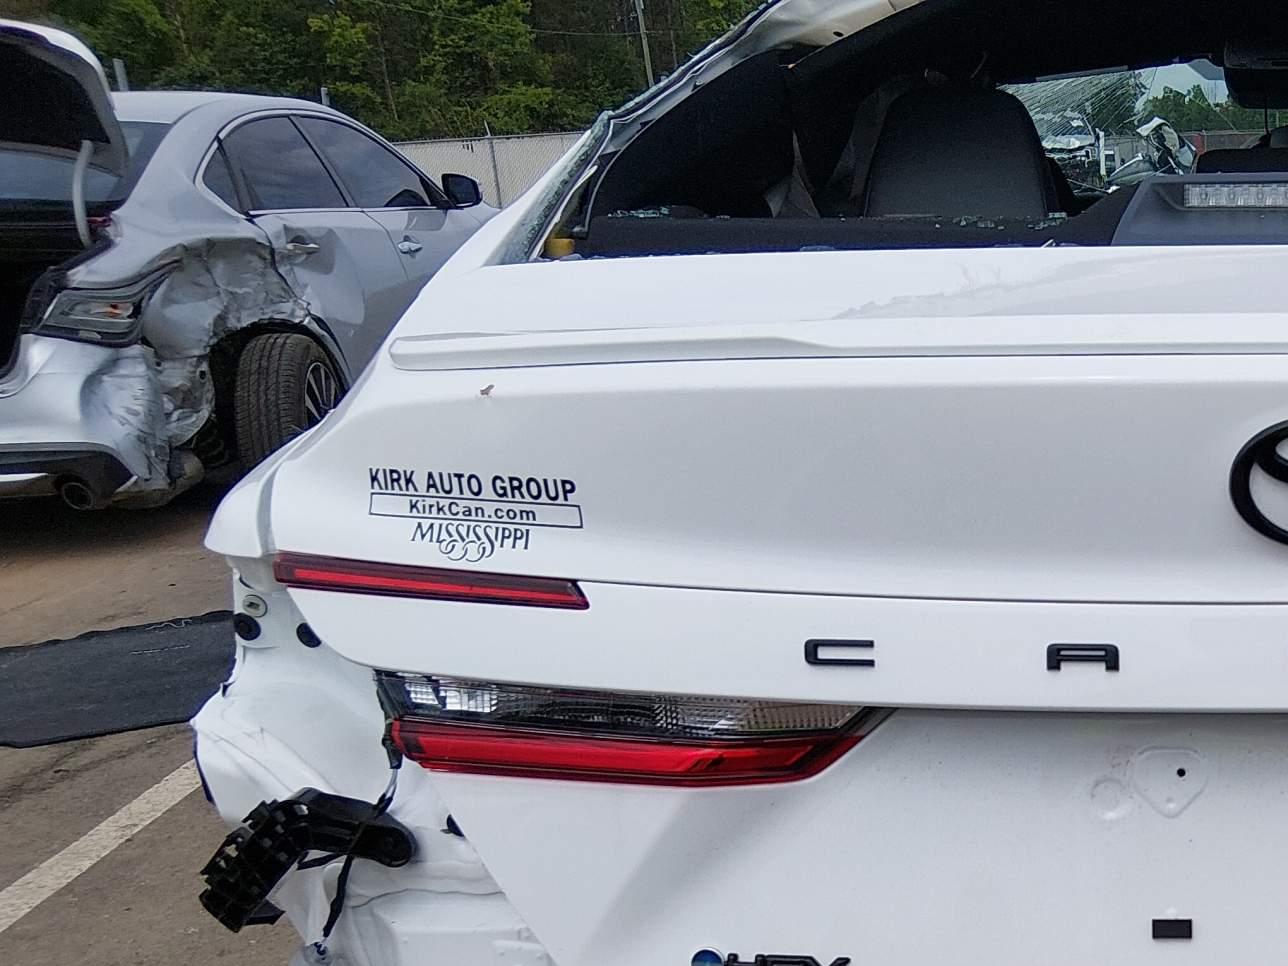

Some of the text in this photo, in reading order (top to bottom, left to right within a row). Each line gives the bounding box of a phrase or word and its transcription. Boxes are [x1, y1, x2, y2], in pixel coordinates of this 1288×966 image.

[369, 467, 577, 501] KIRK AUTO GROUP
[408, 498, 537, 522] KirkCan.com
[411, 522, 530, 562] MISSISSIPPI
